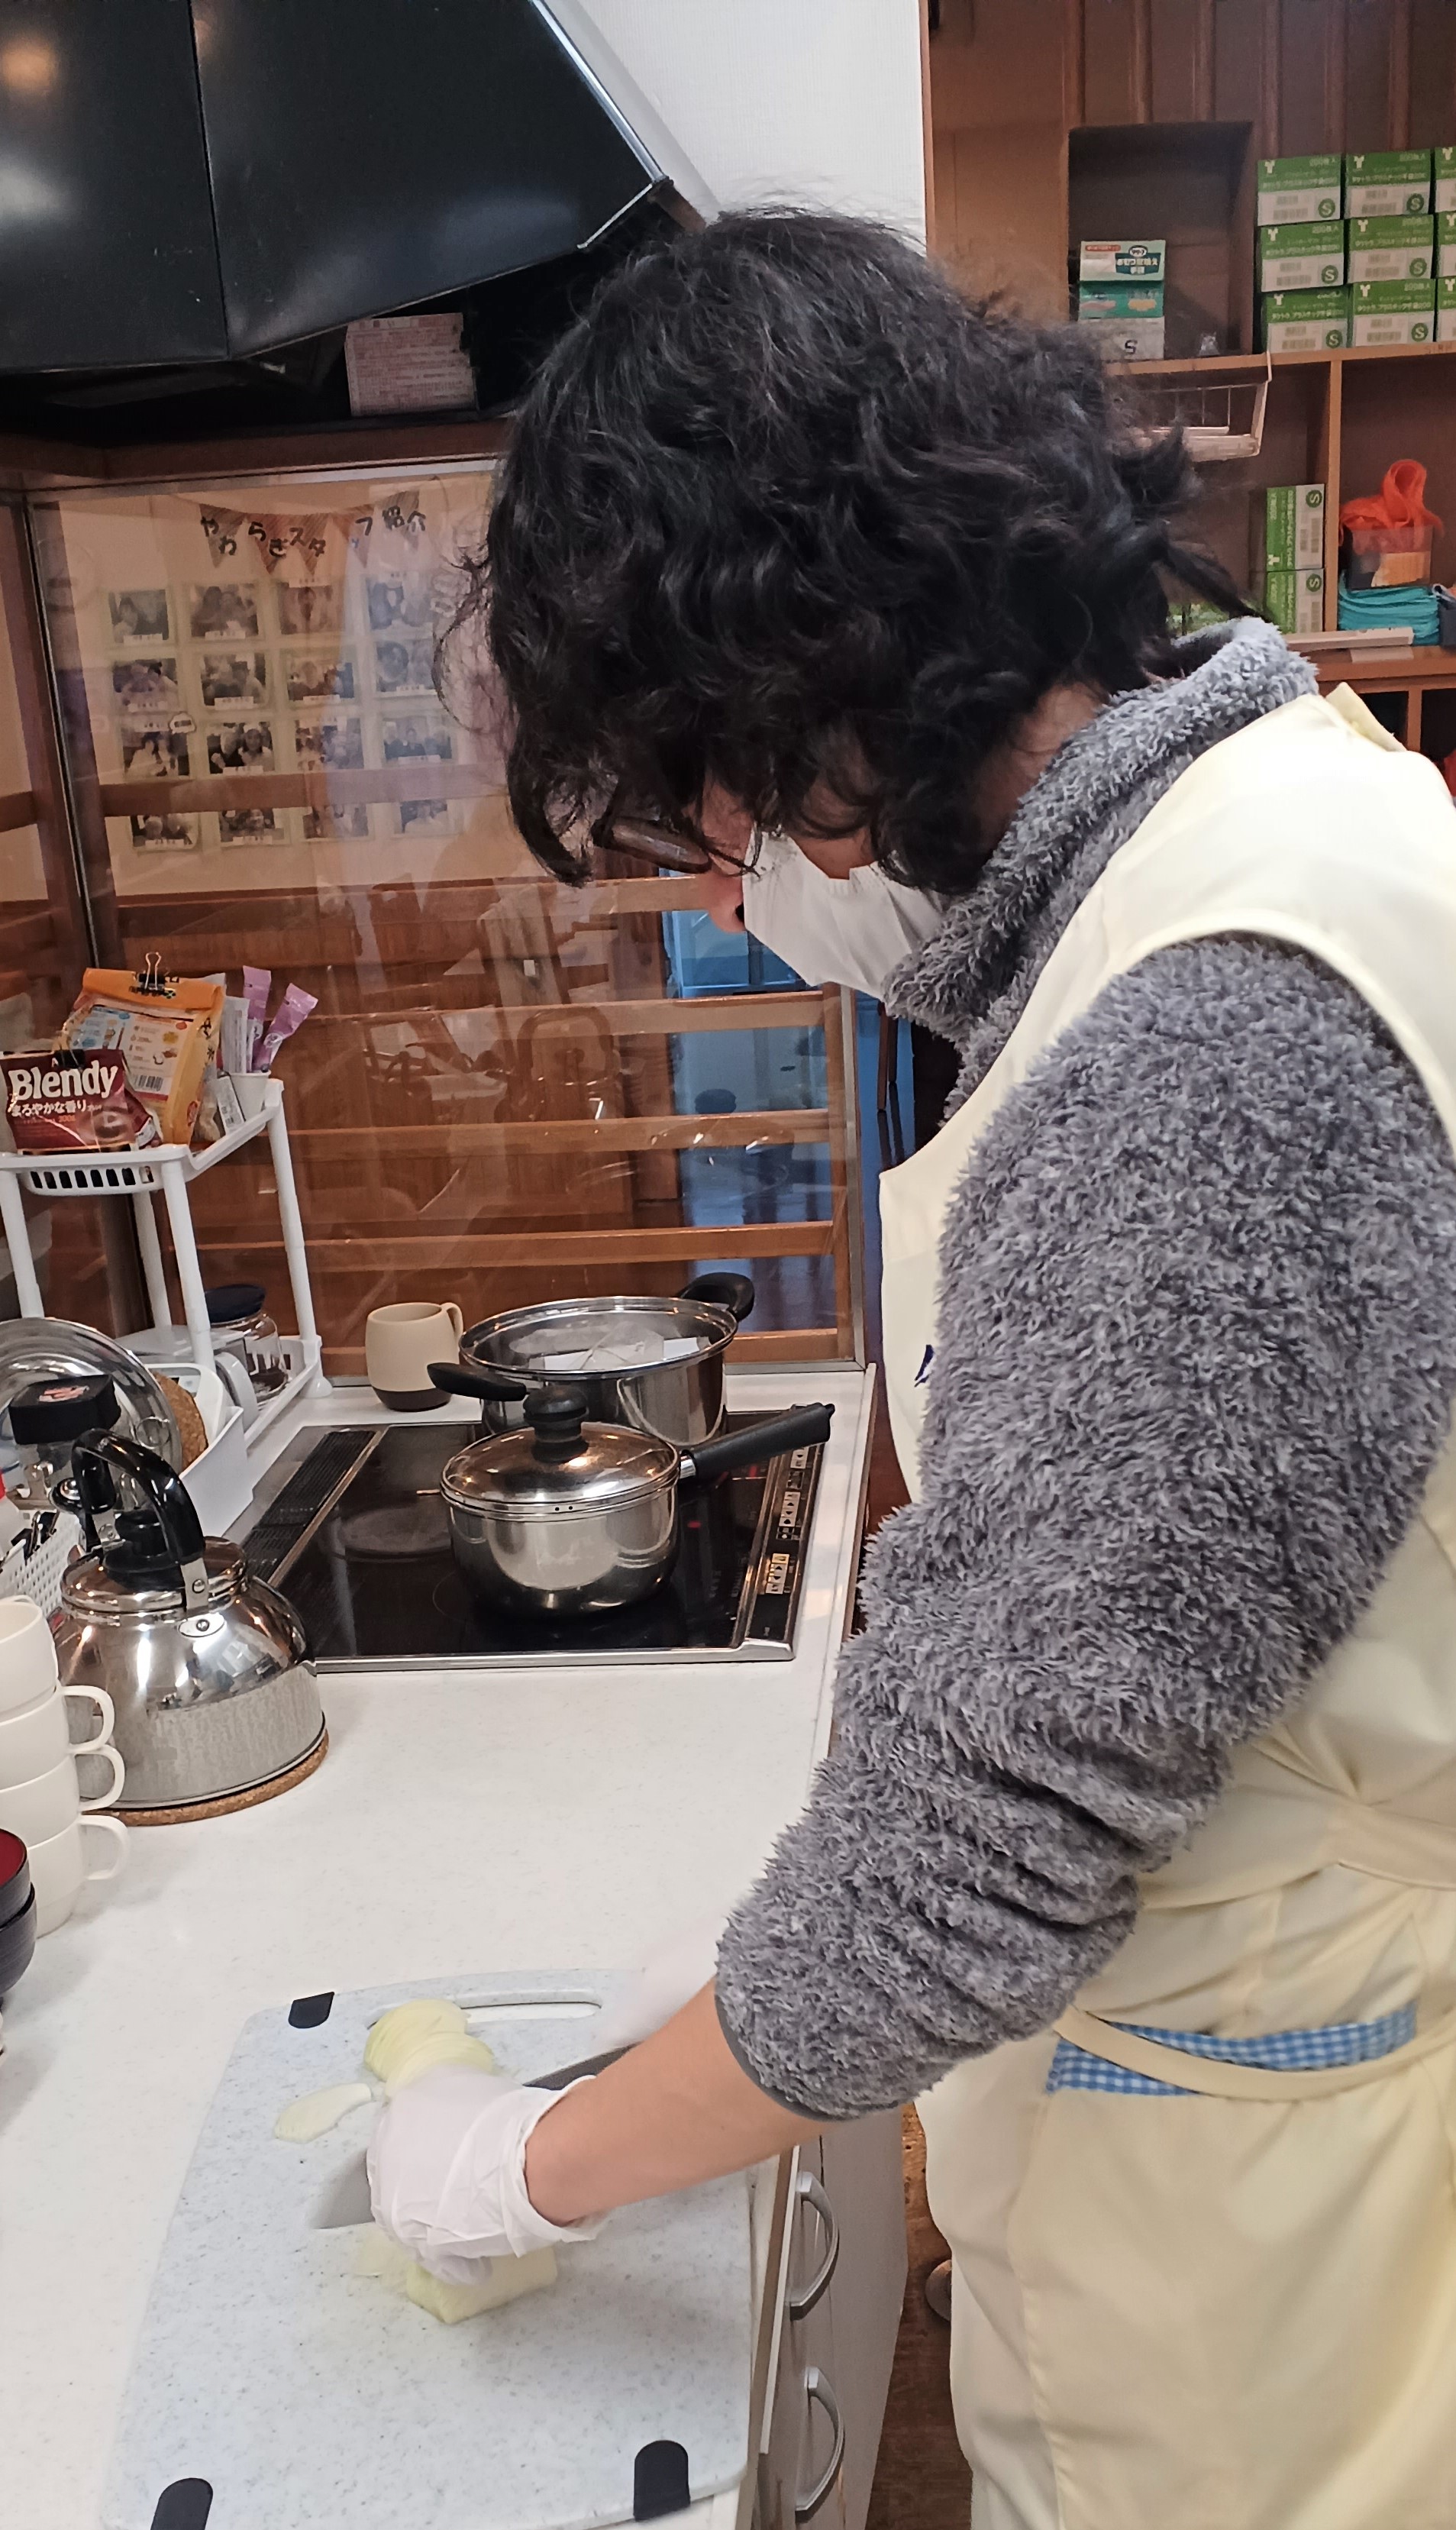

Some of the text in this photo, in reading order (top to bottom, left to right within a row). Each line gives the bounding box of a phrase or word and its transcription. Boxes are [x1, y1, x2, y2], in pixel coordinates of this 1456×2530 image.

[8, 1060, 118, 1100] Blendy
[11, 1099, 86, 1117] まろやかな香り
